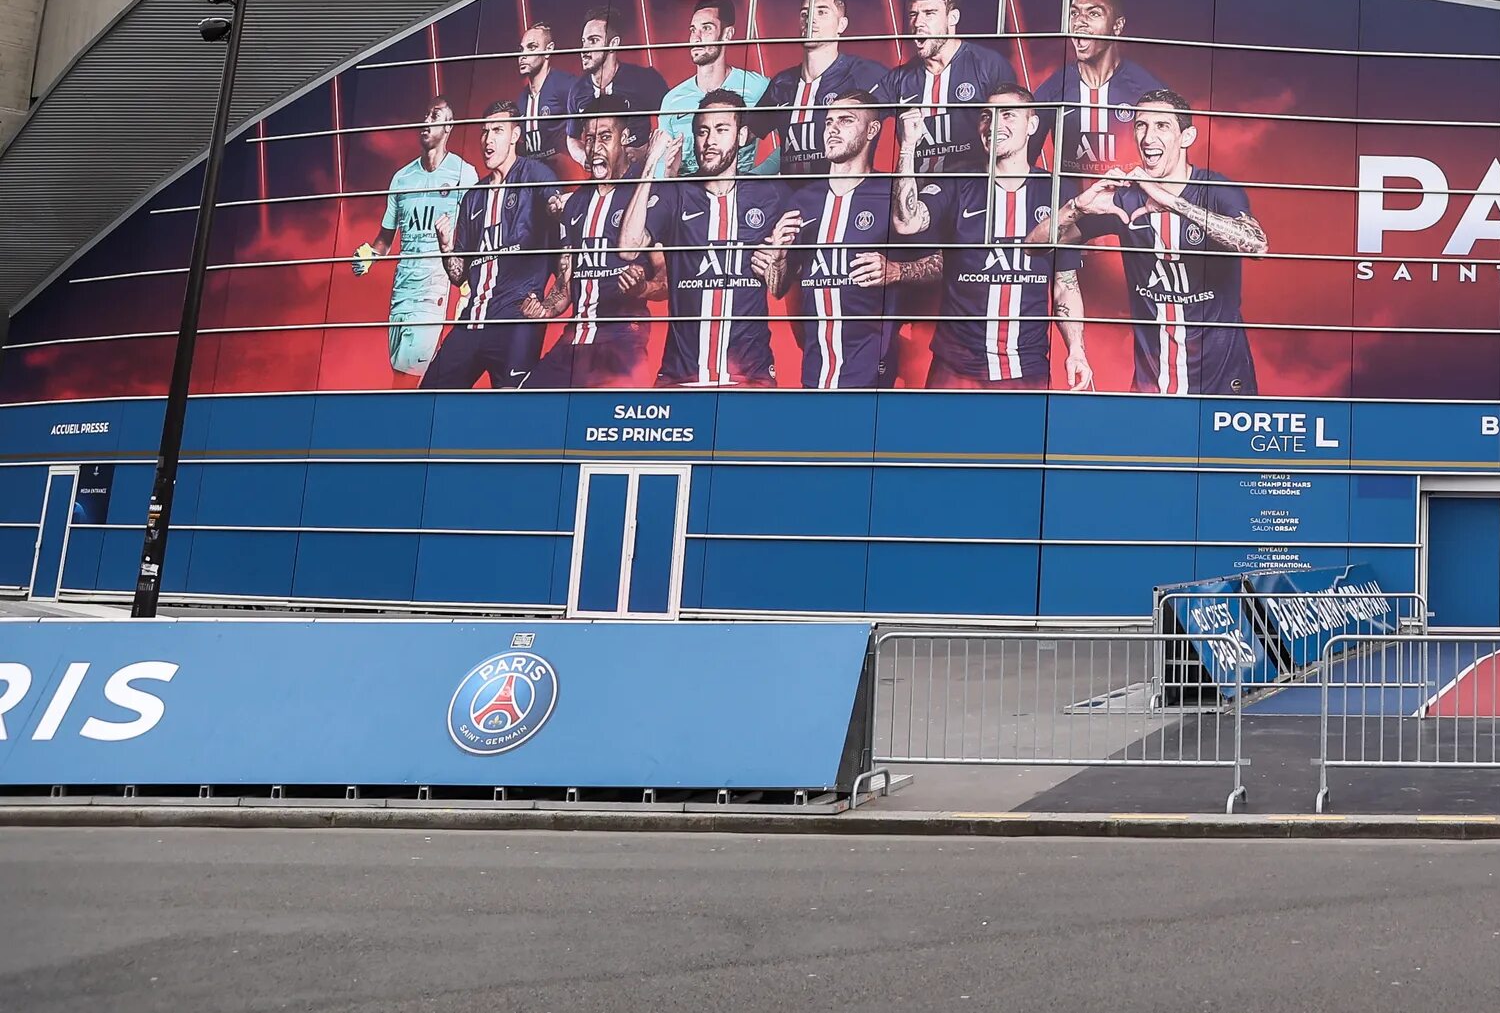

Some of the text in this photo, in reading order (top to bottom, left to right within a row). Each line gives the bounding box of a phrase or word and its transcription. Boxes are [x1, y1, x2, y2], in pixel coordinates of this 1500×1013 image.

[704, 278, 724, 288] LIVE
[815, 278, 832, 287] LIVE
[957, 274, 1047, 284] ACCOR LIVE LIMITLESS
[1154, 293, 1173, 303] LIVE
[1173, 291, 1215, 304] LIMITLESS
[614, 405, 670, 419] SALON
[51, 422, 109, 435] ACCUEIL PRESSE
[586, 428, 694, 442] DES PRINCES
[1213, 412, 1339, 447] PORTE L
[1250, 435, 1306, 452] GATE
[478, 657, 547, 681] PARIS
[460, 724, 480, 743] SAINT
[485, 725, 527, 745] GERMAIN
